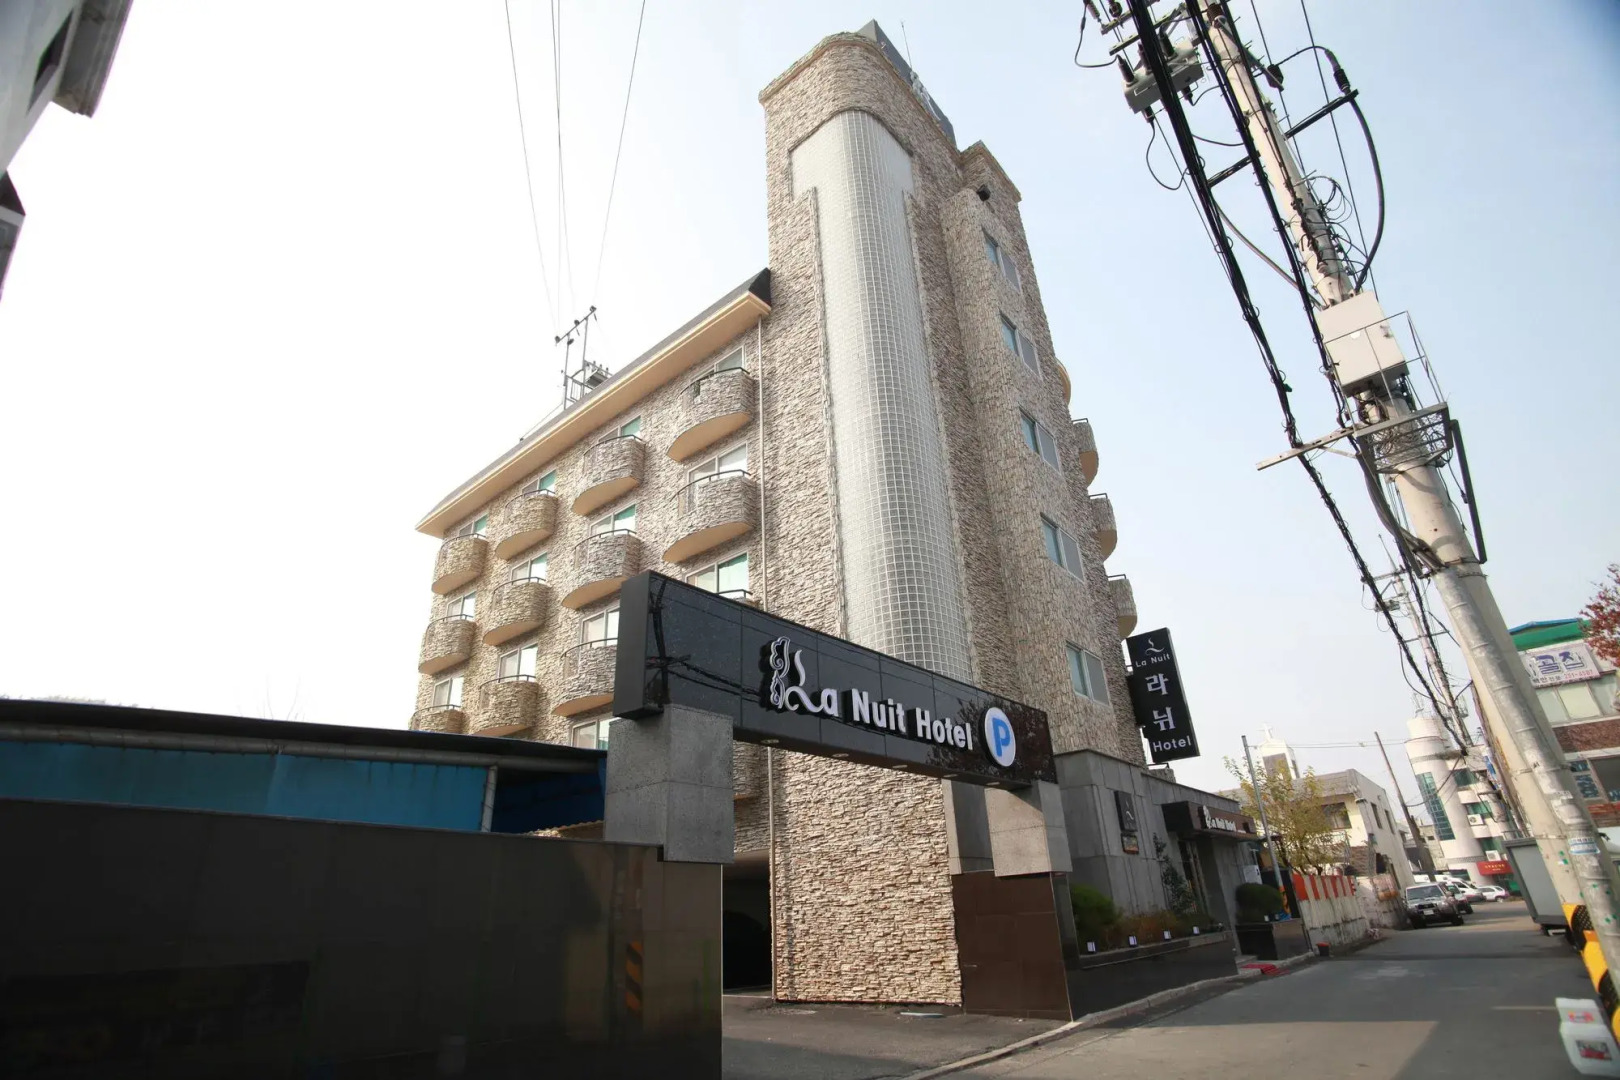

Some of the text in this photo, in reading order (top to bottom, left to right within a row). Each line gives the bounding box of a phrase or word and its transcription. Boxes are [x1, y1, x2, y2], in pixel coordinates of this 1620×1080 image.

[1135, 653, 1171, 668] La Nuit
[1523, 651, 1585, 677] 골집
[1144, 673, 1176, 732] 라뉘
[851, 688, 907, 734] Nuit
[915, 707, 973, 751] Hotel
[1152, 735, 1192, 753] Hotel
